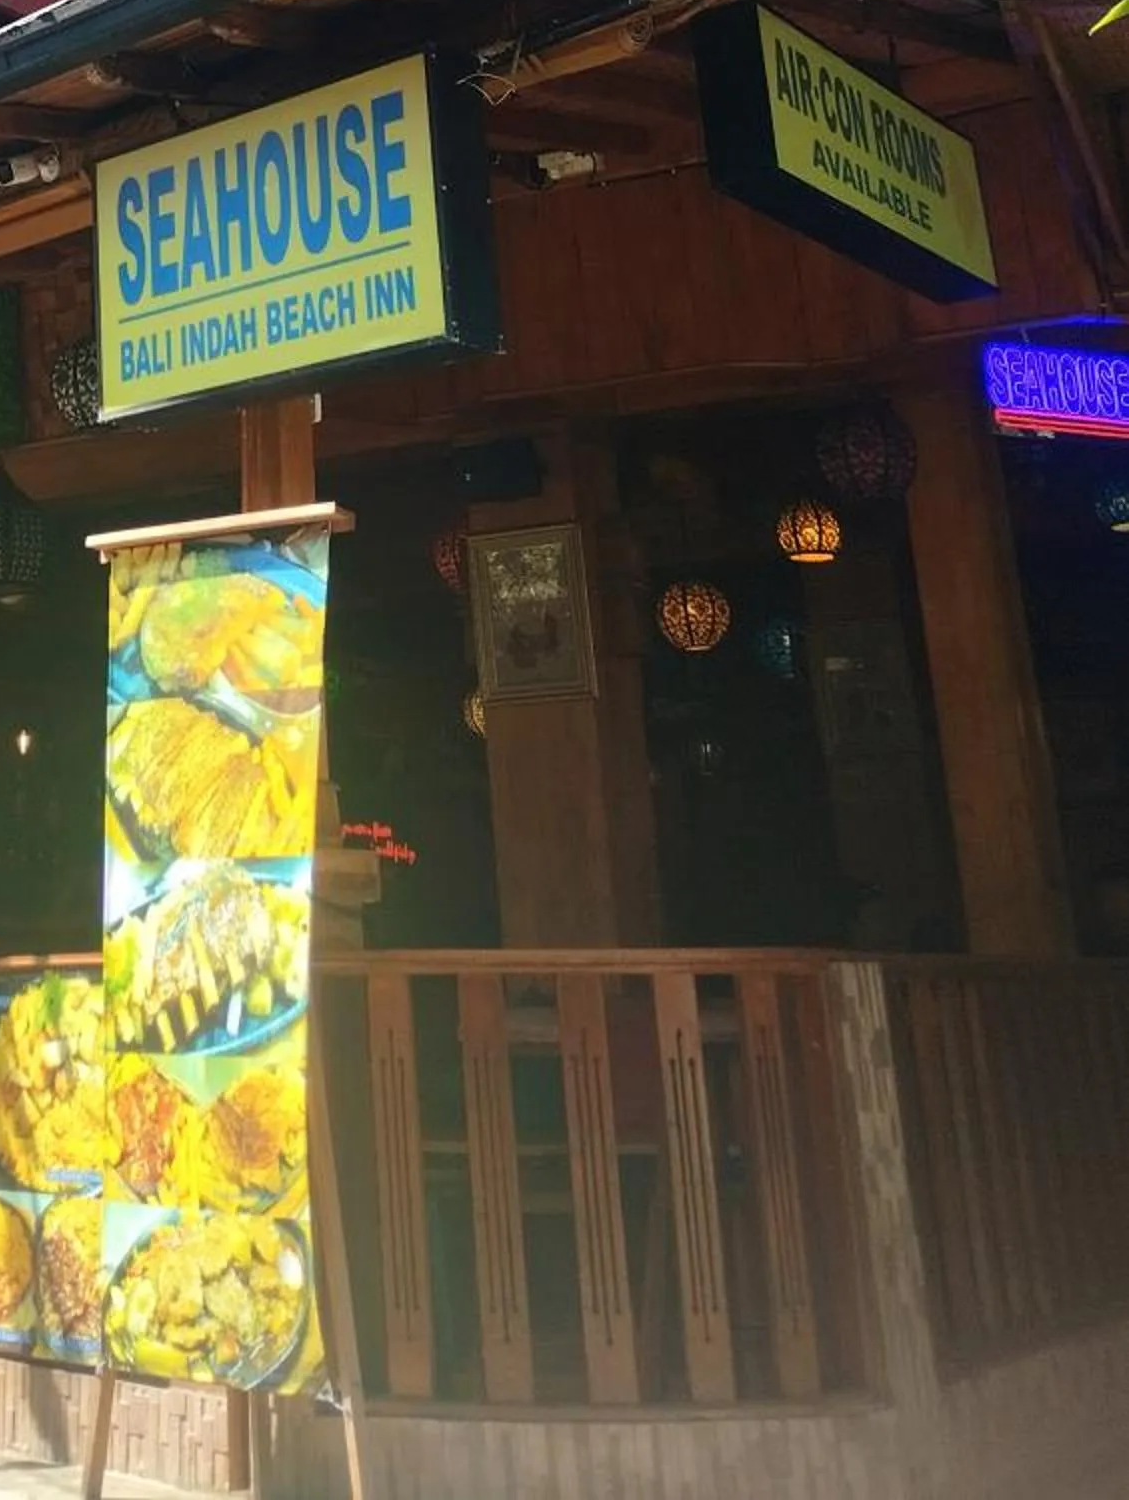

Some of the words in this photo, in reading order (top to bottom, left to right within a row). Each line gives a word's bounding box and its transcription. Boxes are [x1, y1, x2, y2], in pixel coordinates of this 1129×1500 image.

[117, 90, 412, 306] SEAHOUSE
[813, 139, 933, 231] AVAILABLE
[871, 100, 946, 198] ROOMS
[120, 333, 172, 382] BALI
[180, 307, 258, 366] INDAH
[266, 279, 356, 346] BEACH
[366, 266, 416, 319] INN
